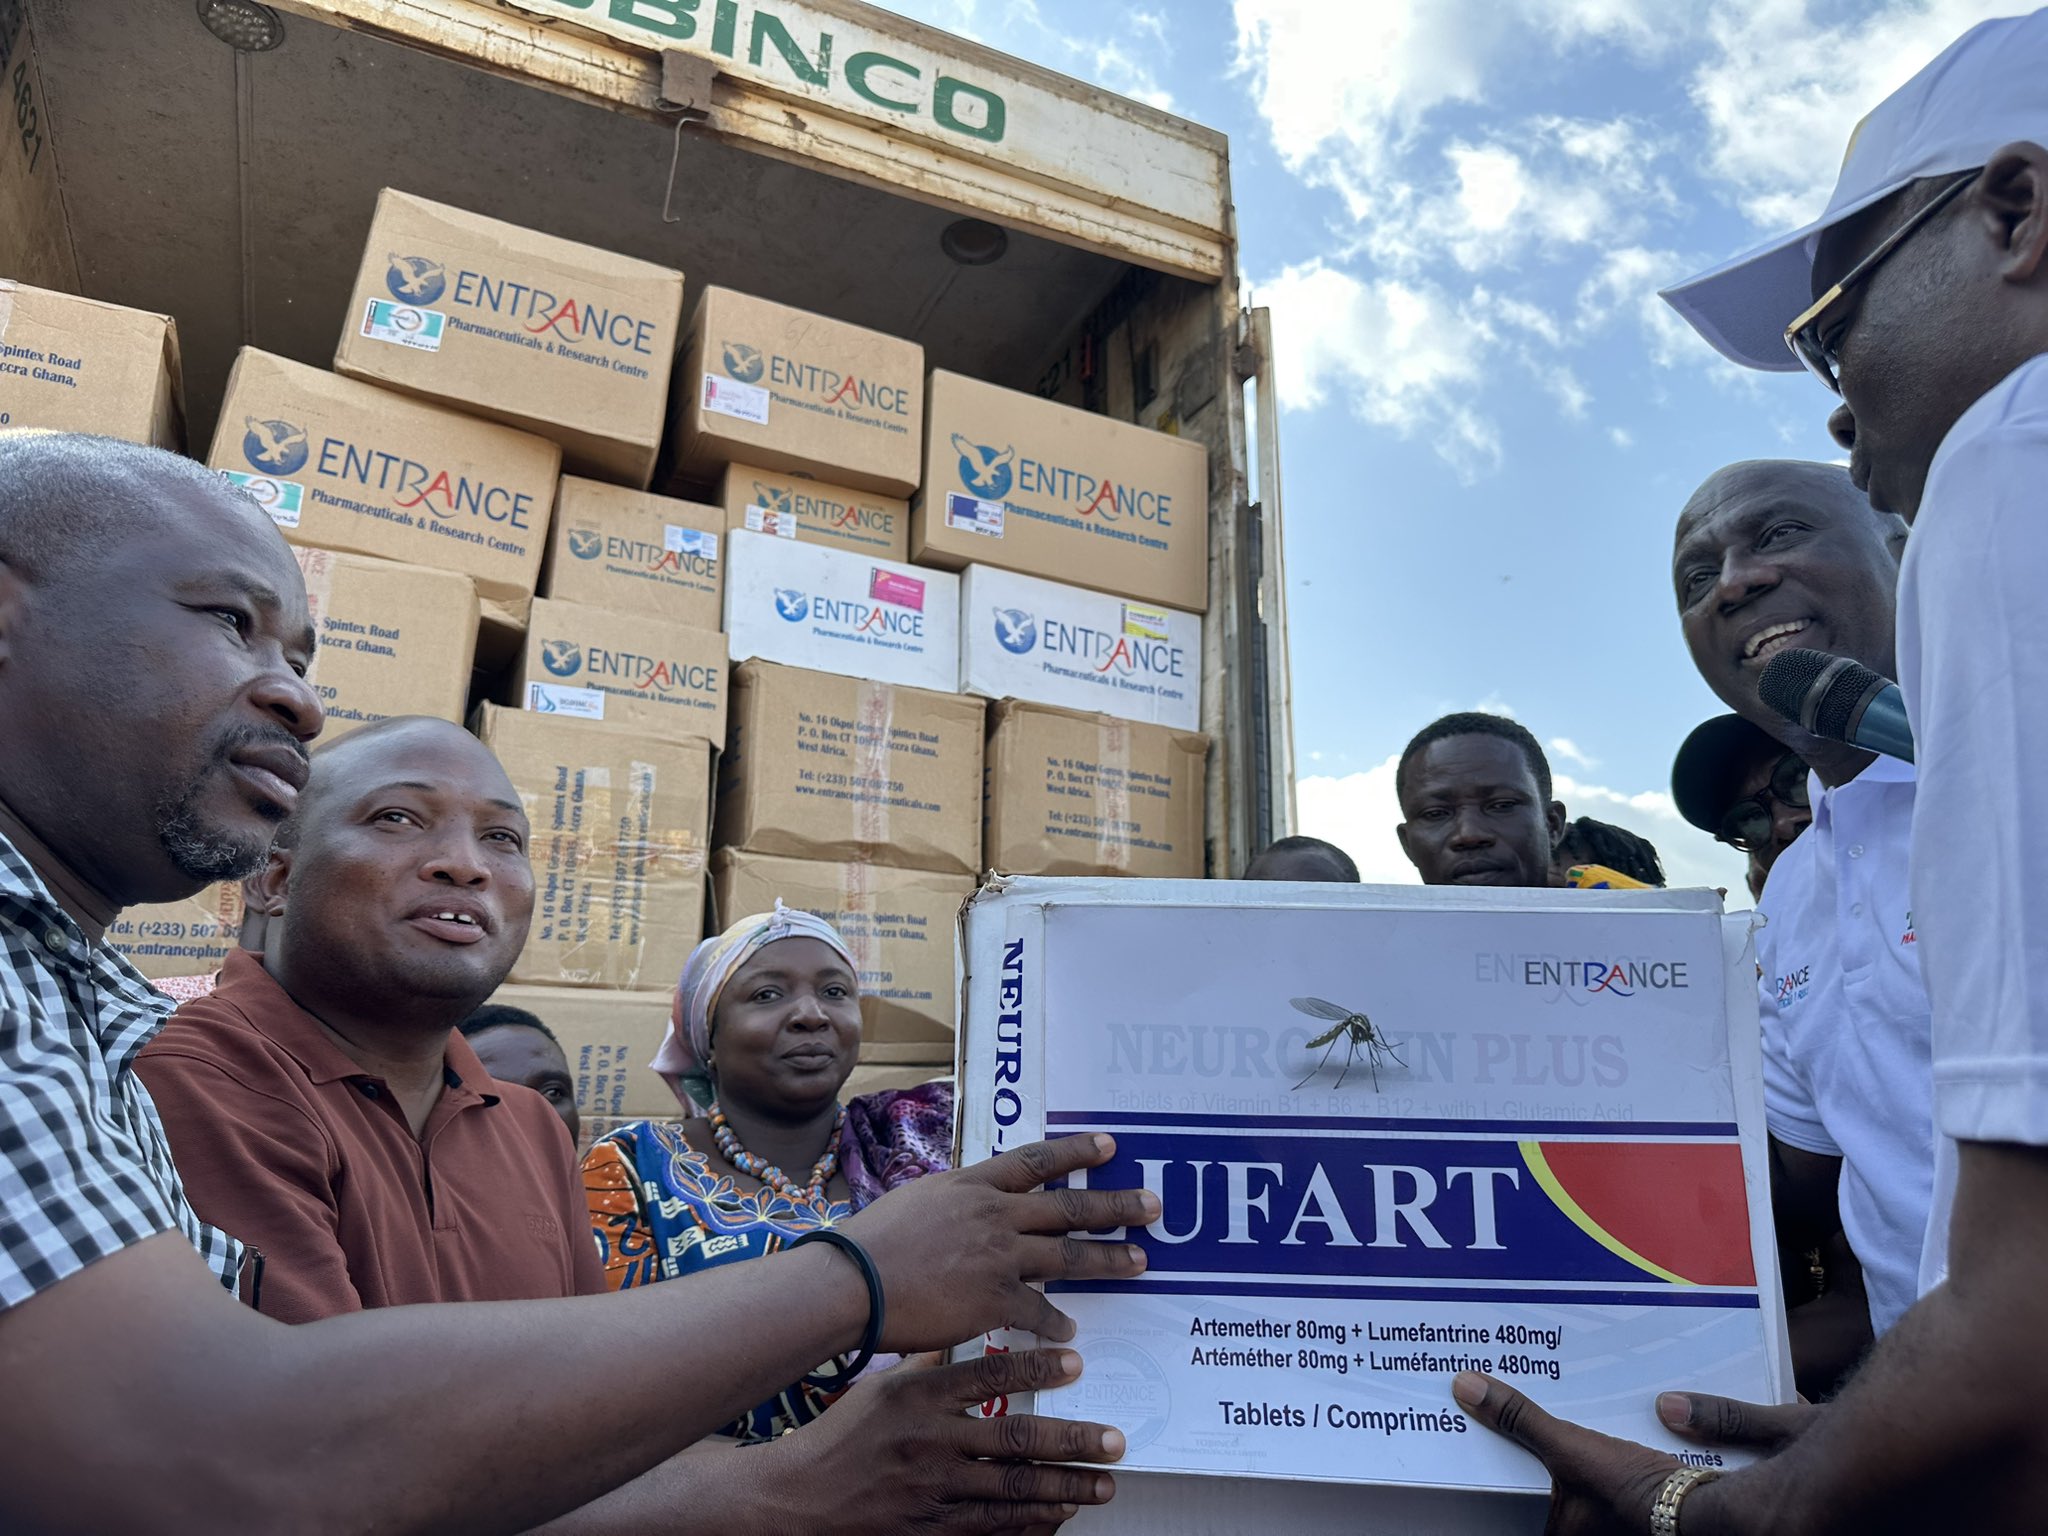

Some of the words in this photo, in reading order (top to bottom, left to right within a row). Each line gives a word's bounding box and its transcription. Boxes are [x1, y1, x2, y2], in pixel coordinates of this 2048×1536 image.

[556, 0, 1006, 143] BINCO
[454, 271, 655, 354] ENTRANCE
[48, 353, 82, 370] Road
[448, 316, 542, 351] Pharmaceuticals
[558, 344, 609, 368] Research
[613, 360, 649, 379] Centre
[0, 361, 28, 376] ccra
[32, 367, 77, 388] Ghana,
[771, 356, 908, 415] ENTRANCE
[317, 438, 533, 529] ENTRANCE
[1019, 458, 1172, 526] ENTRANCE
[311, 488, 413, 527] Pharmaceuticals
[430, 520, 484, 545] Research
[488, 536, 526, 557] Centre
[795, 496, 893, 533] ENTRANCE
[1004, 501, 1084, 531] Pharmaceuticals
[1094, 523, 1136, 543] Research
[1139, 534, 1169, 551] Centre
[607, 537, 717, 579] ENTRANCE
[323, 616, 366, 635] Spintex
[369, 624, 400, 640] Road
[813, 597, 924, 637] ENTRANCE
[318, 633, 352, 650] Accra
[356, 639, 396, 658] Ghana,
[1044, 620, 1183, 677] ENTRANCE
[588, 648, 718, 692] ENTRANCE
[1043, 662, 1109, 687] Pharmaceuticals
[1120, 678, 1155, 694] Research
[1158, 686, 1183, 700] Centre
[315, 685, 337, 699] 750
[816, 715, 828, 725] 16
[799, 769, 814, 781] Tel:
[817, 772, 847, 786] (+233)
[543, 906, 555, 919] 16
[555, 765, 568, 791] Road
[138, 921, 186, 939] (+233)
[191, 924, 218, 937] 507
[1525, 962, 1688, 997] ENTRANCE
[1775, 965, 1809, 1000] RANCE
[993, 937, 1023, 1157] NEURO-
[1473, 1033, 1629, 1089] PLUS
[614, 1068, 626, 1082] 16
[1109, 1089, 1173, 1112] Tablets
[1178, 1090, 1196, 1111] of
[1201, 1092, 1271, 1113] Vitamin
[1439, 1099, 1476, 1119] with
[1190, 1317, 1291, 1339] Artemether
[1296, 1320, 1346, 1344] 80mg
[1352, 1325, 1363, 1338] +
[1369, 1321, 1490, 1344] Lumefantrine
[1495, 1324, 1562, 1350] 480mg/
[1190, 1347, 1292, 1369] Artéméther
[1297, 1350, 1348, 1374] 80mg
[1354, 1355, 1365, 1368] +
[1370, 1350, 1493, 1374] Luméfantrine
[1498, 1354, 1560, 1380] 480mg
[1219, 1401, 1305, 1427] Tablets
[1313, 1404, 1320, 1428] /
[1327, 1404, 1467, 1435] Comprimés
[1670, 1449, 1723, 1466] rimés
